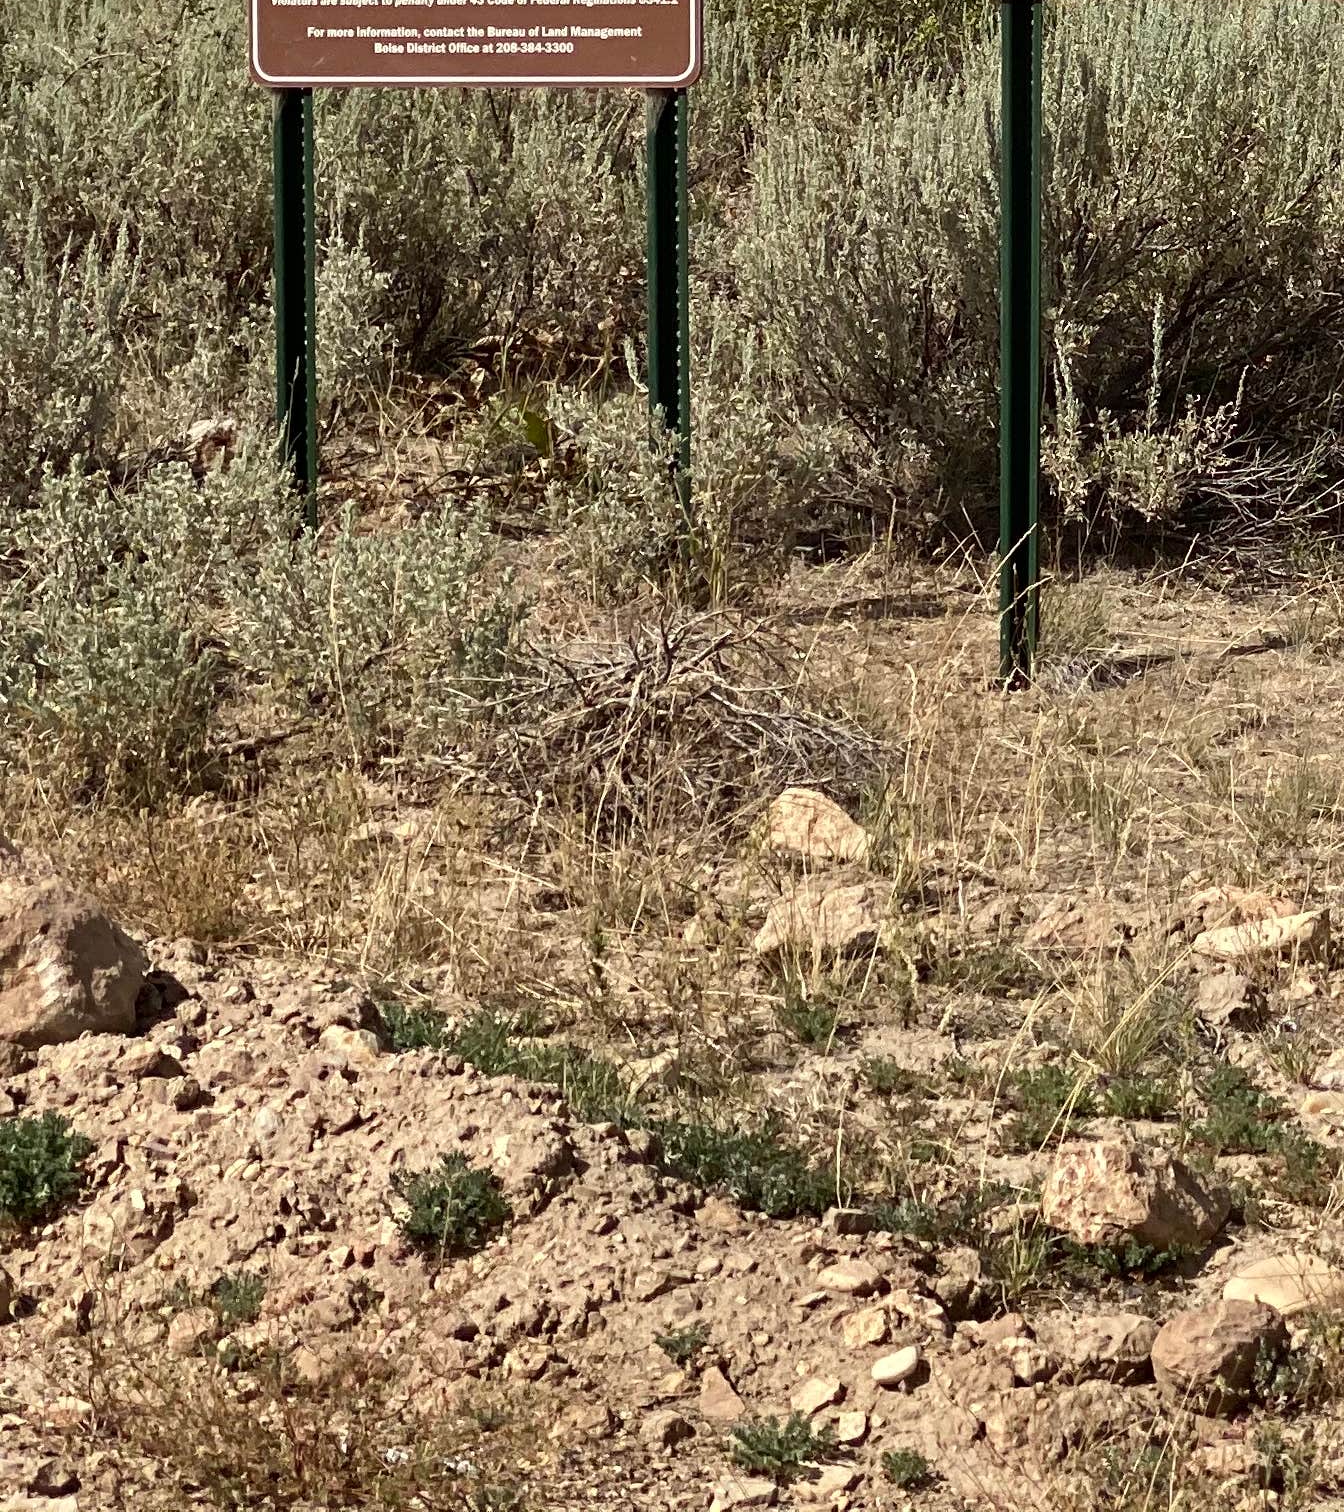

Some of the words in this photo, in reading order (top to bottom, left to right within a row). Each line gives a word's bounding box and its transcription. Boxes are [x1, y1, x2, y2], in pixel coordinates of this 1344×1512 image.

[374, 42, 405, 54] Boise
[406, 42, 447, 54] District
[448, 42, 480, 54] Office
[481, 42, 494, 54] at
[495, 41, 574, 54] 208-384-3300
